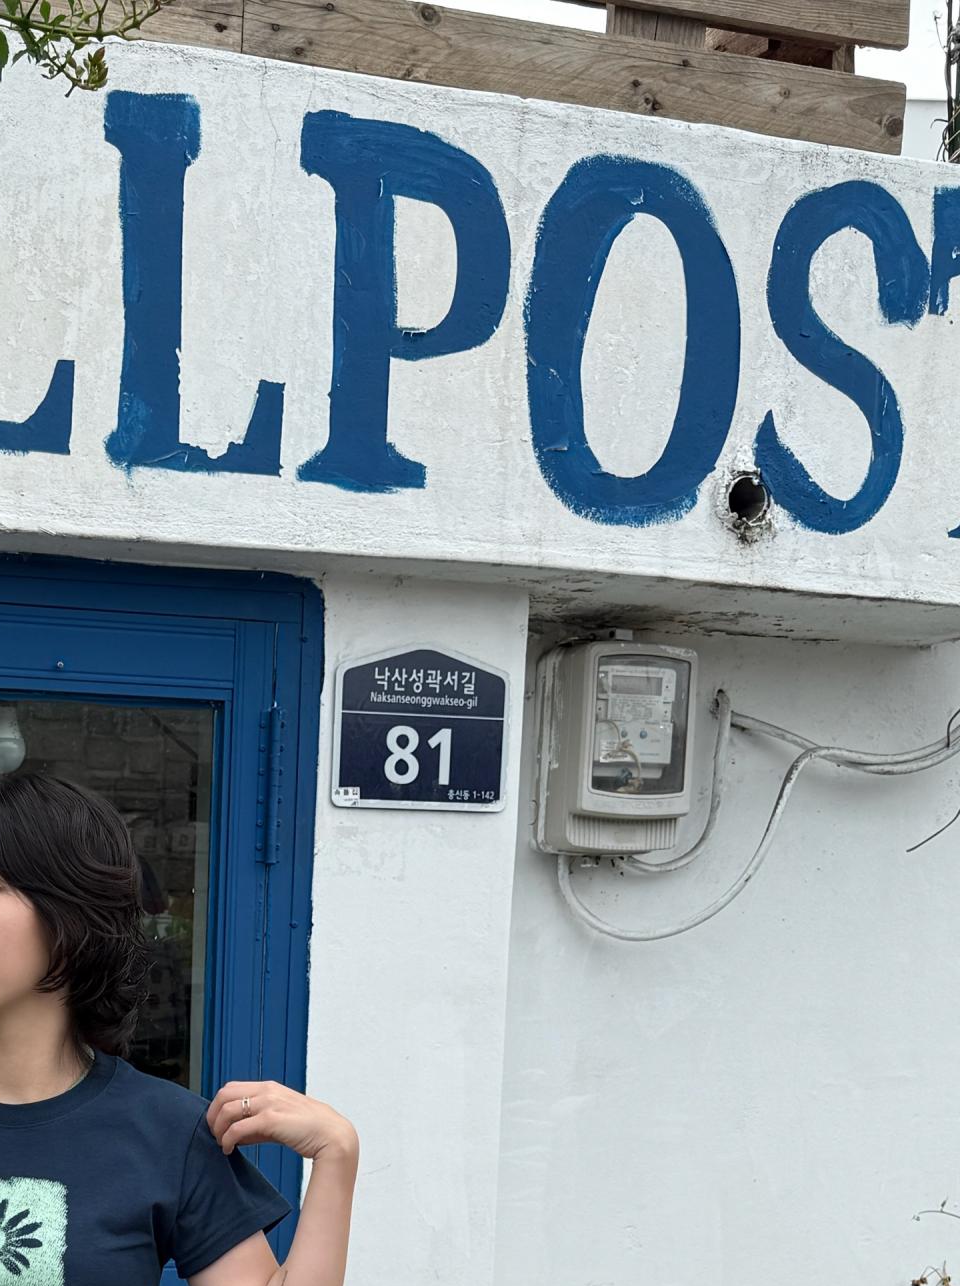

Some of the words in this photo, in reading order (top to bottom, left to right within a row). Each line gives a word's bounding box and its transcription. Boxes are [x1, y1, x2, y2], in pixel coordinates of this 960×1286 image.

[374, 667, 476, 695] 낙산성곽서길
[370, 691, 478, 709] Naksanseonggwakseo-gil
[384, 725, 452, 786] 81
[472, 790, 495, 800] 1-142
